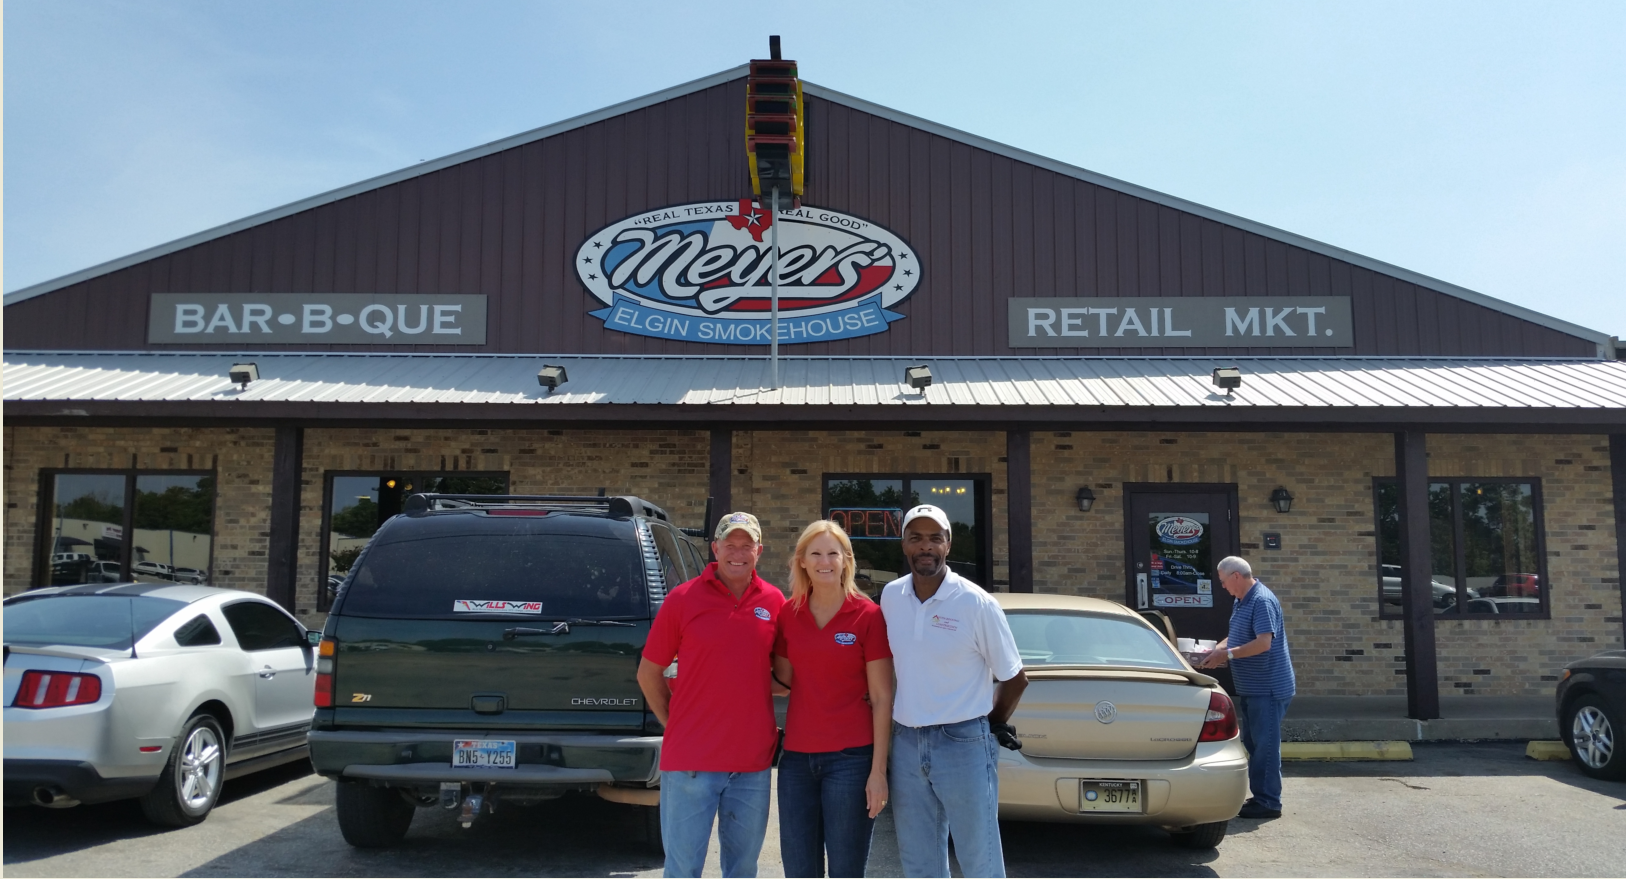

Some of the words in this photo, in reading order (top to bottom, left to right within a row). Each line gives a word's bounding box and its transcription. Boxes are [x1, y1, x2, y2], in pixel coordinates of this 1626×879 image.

[684, 204, 734, 217] TEXAS
[614, 306, 688, 336] ELGIN
[697, 308, 879, 341] SMOKEHOUSE
[1027, 306, 1192, 338] RETAIL
[1224, 306, 1334, 337] MKT.
[1164, 596, 1202, 604] OPEN
